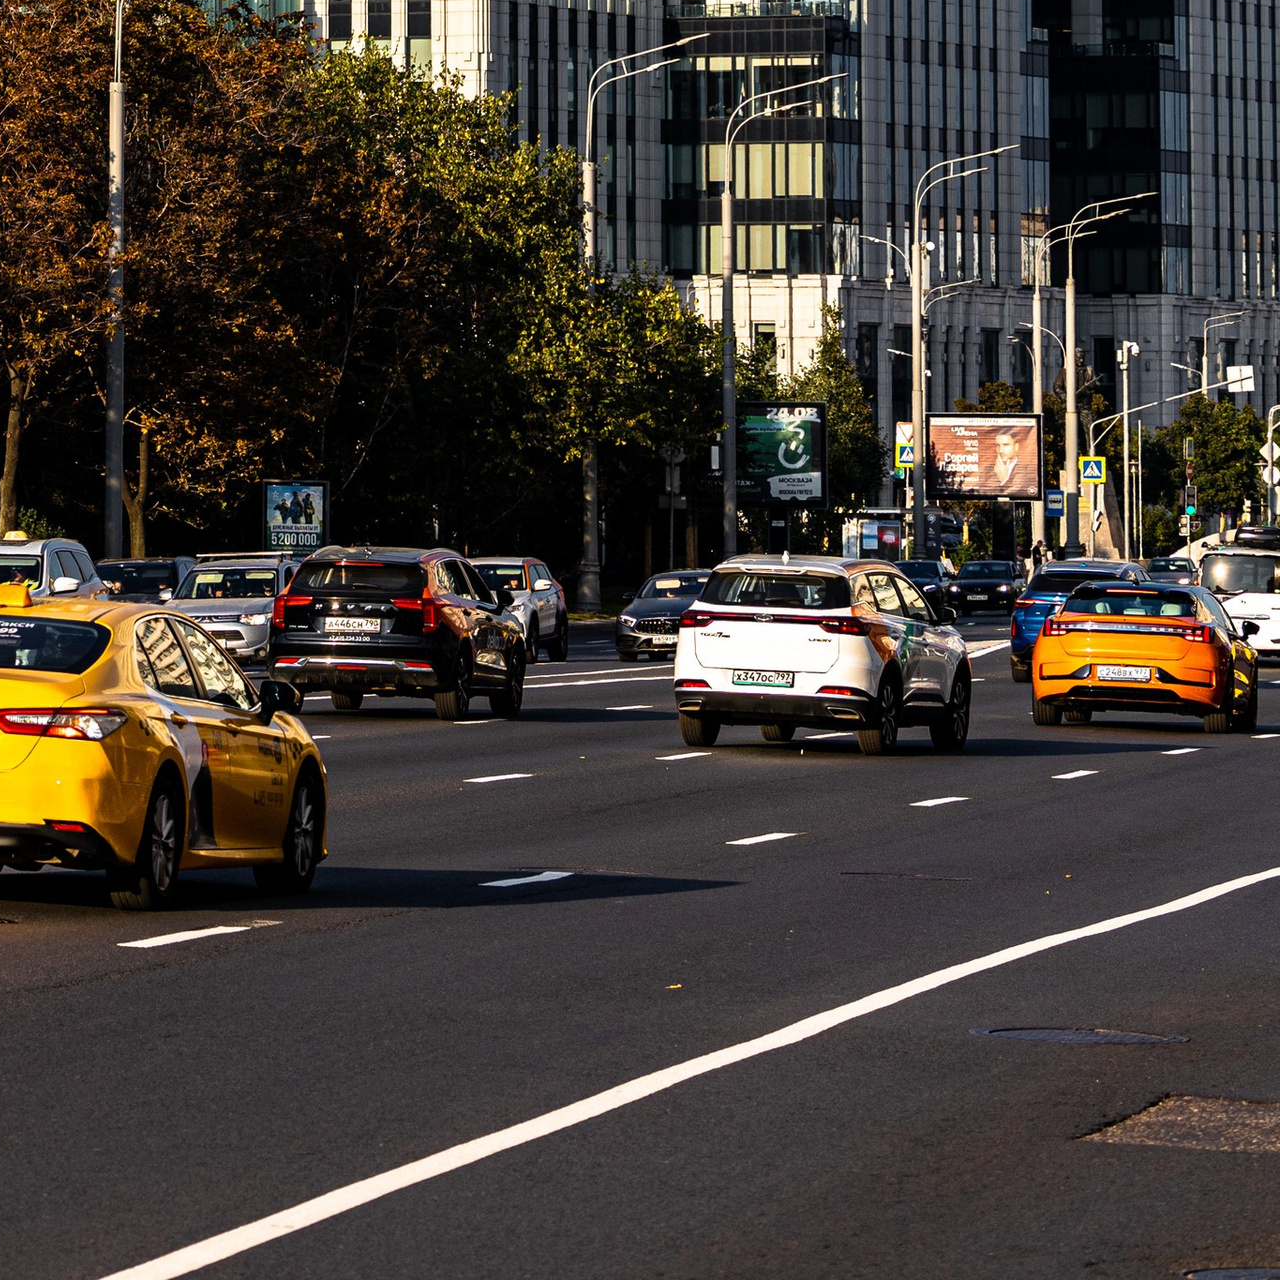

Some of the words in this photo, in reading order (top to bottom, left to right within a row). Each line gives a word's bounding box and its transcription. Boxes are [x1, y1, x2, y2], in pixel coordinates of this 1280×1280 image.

[944, 452, 979, 463] Сергей
[938, 462, 979, 473] Лазарев
[736, 671, 773, 683] Х347ОС
[775, 672, 791, 681] 797
